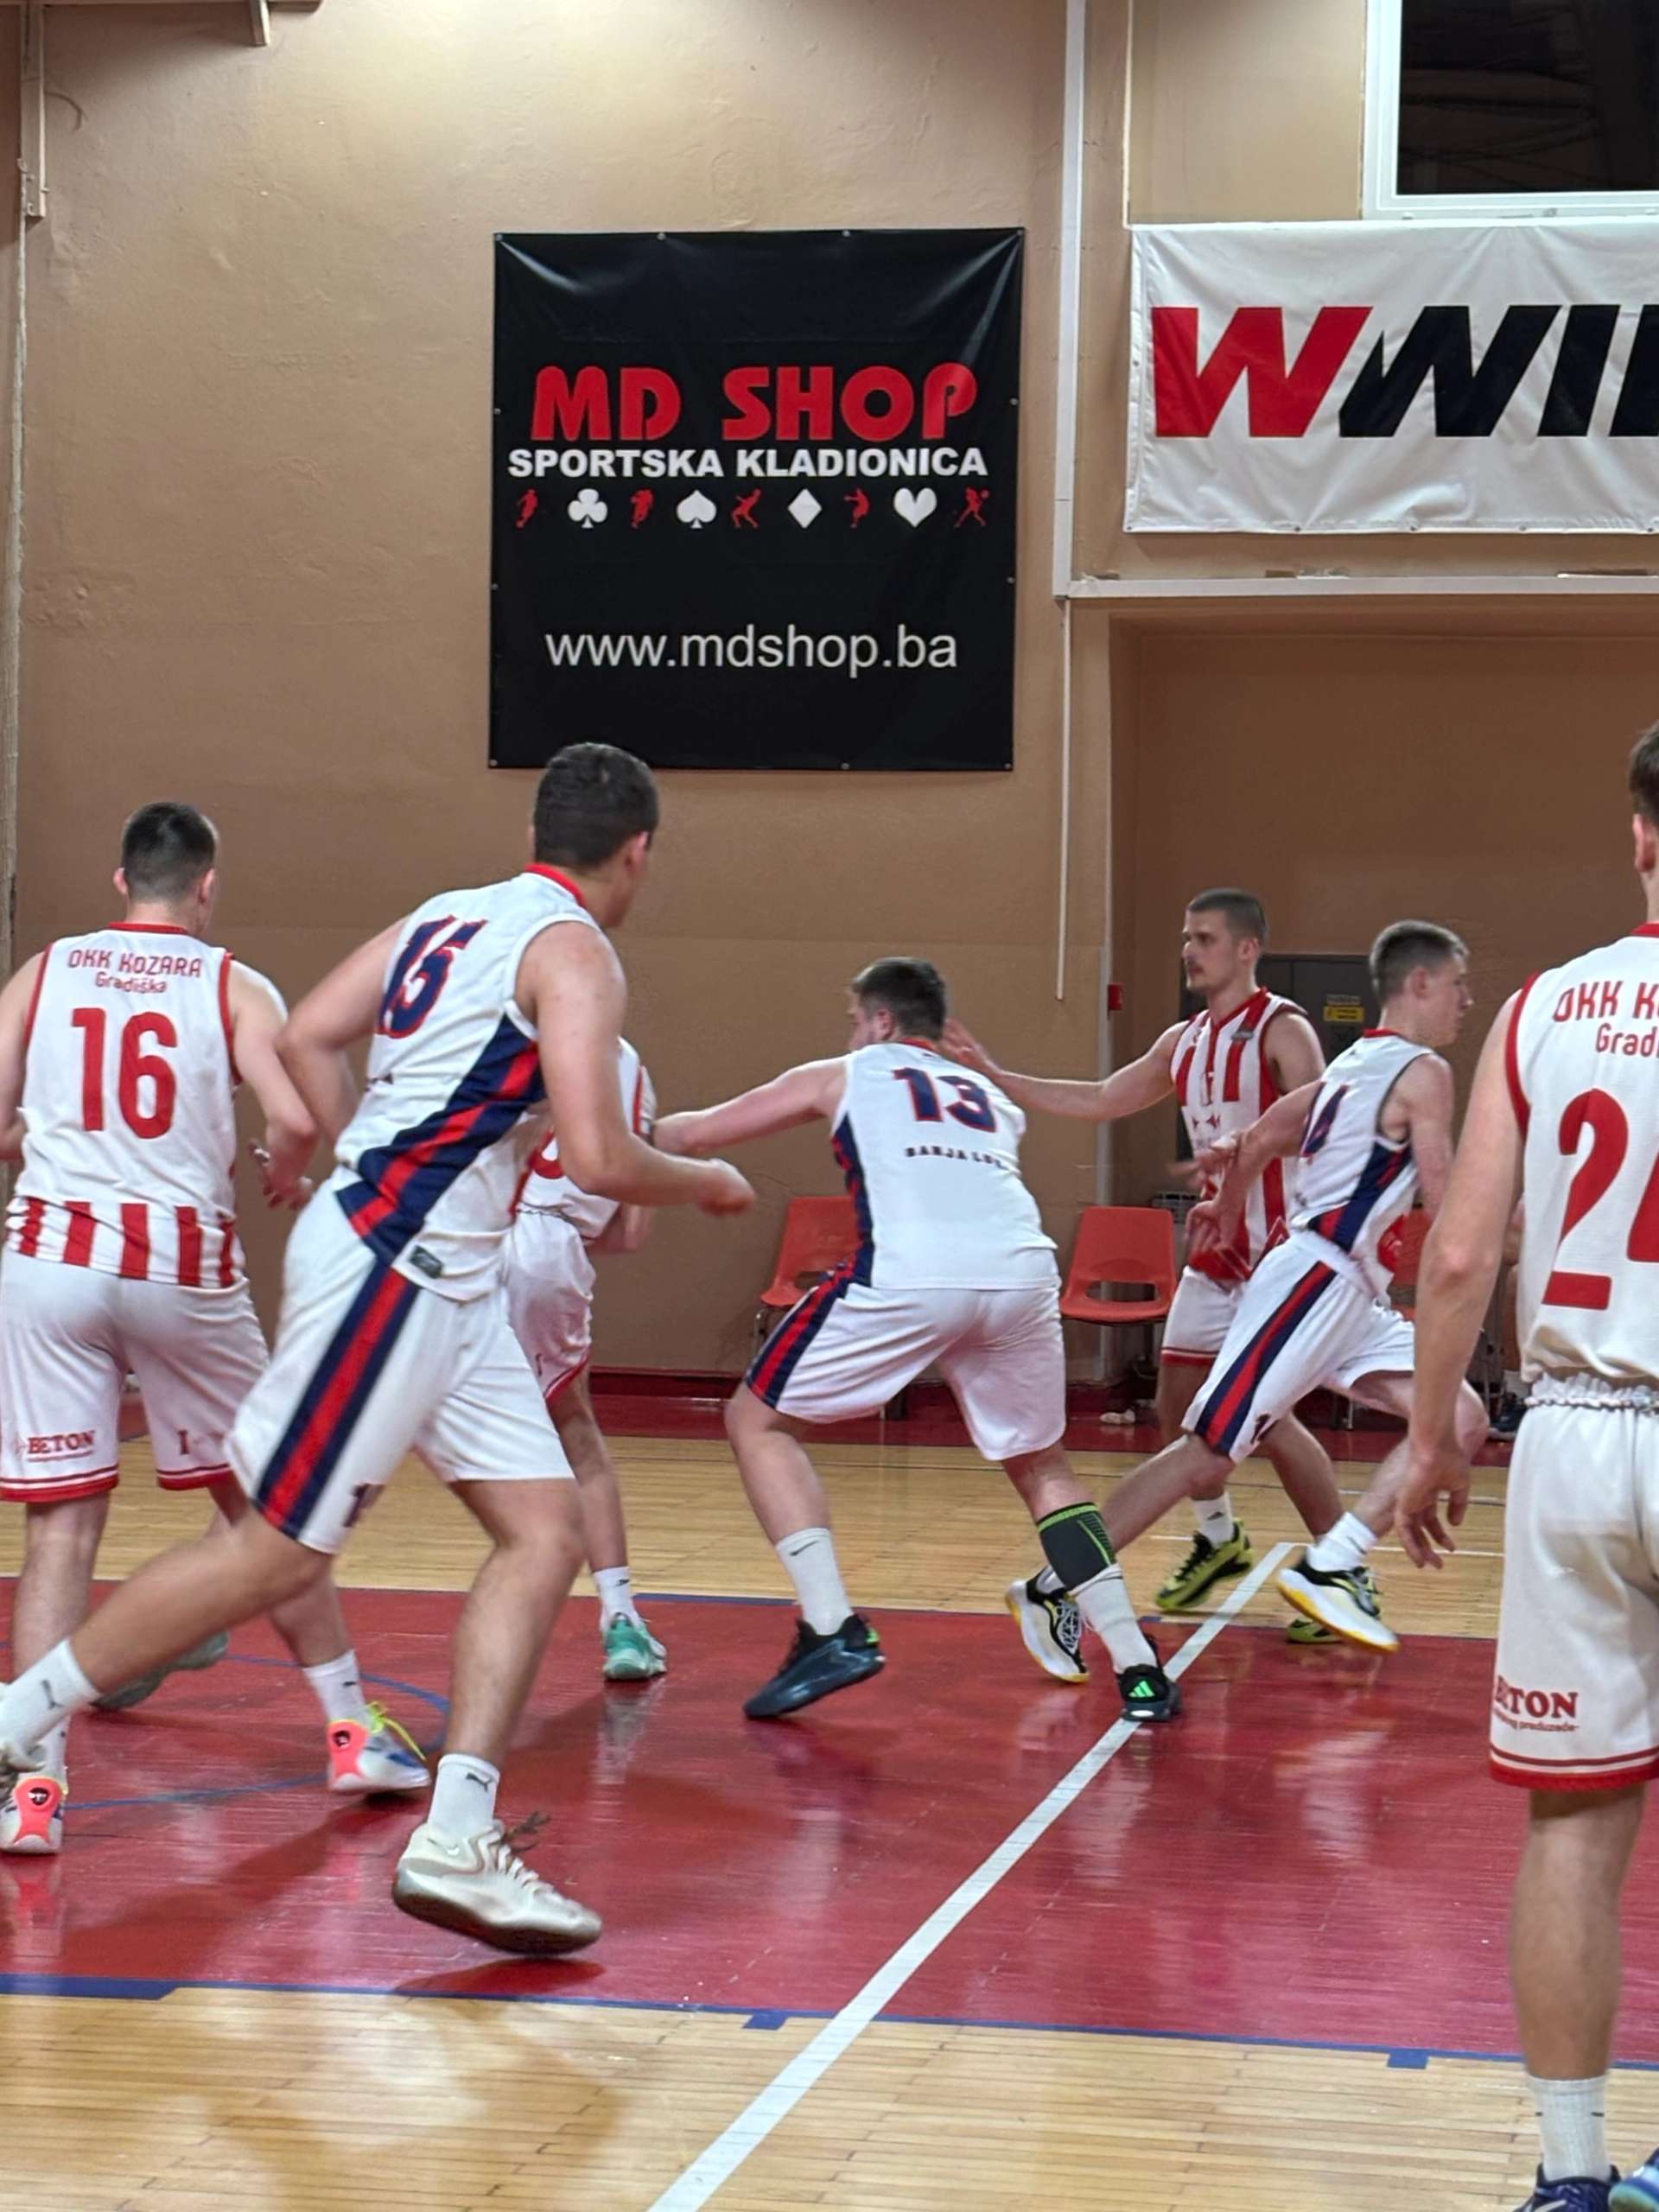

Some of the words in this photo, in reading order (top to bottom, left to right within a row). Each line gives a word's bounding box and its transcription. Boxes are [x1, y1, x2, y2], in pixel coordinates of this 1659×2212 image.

[531, 365, 682, 442] MD
[721, 362, 977, 442] SHOP
[508, 448, 724, 478] SPORTSKA
[736, 447, 988, 477] KLADIONICA
[545, 624, 957, 678] www.mdshop.ba
[67, 949, 113, 969] OKK
[118, 952, 203, 978] KOZARA
[1552, 980, 1624, 1022] OKK
[71, 1007, 178, 1140] 16
[892, 1066, 997, 1134] 13
[27, 1430, 96, 1453] BETON
